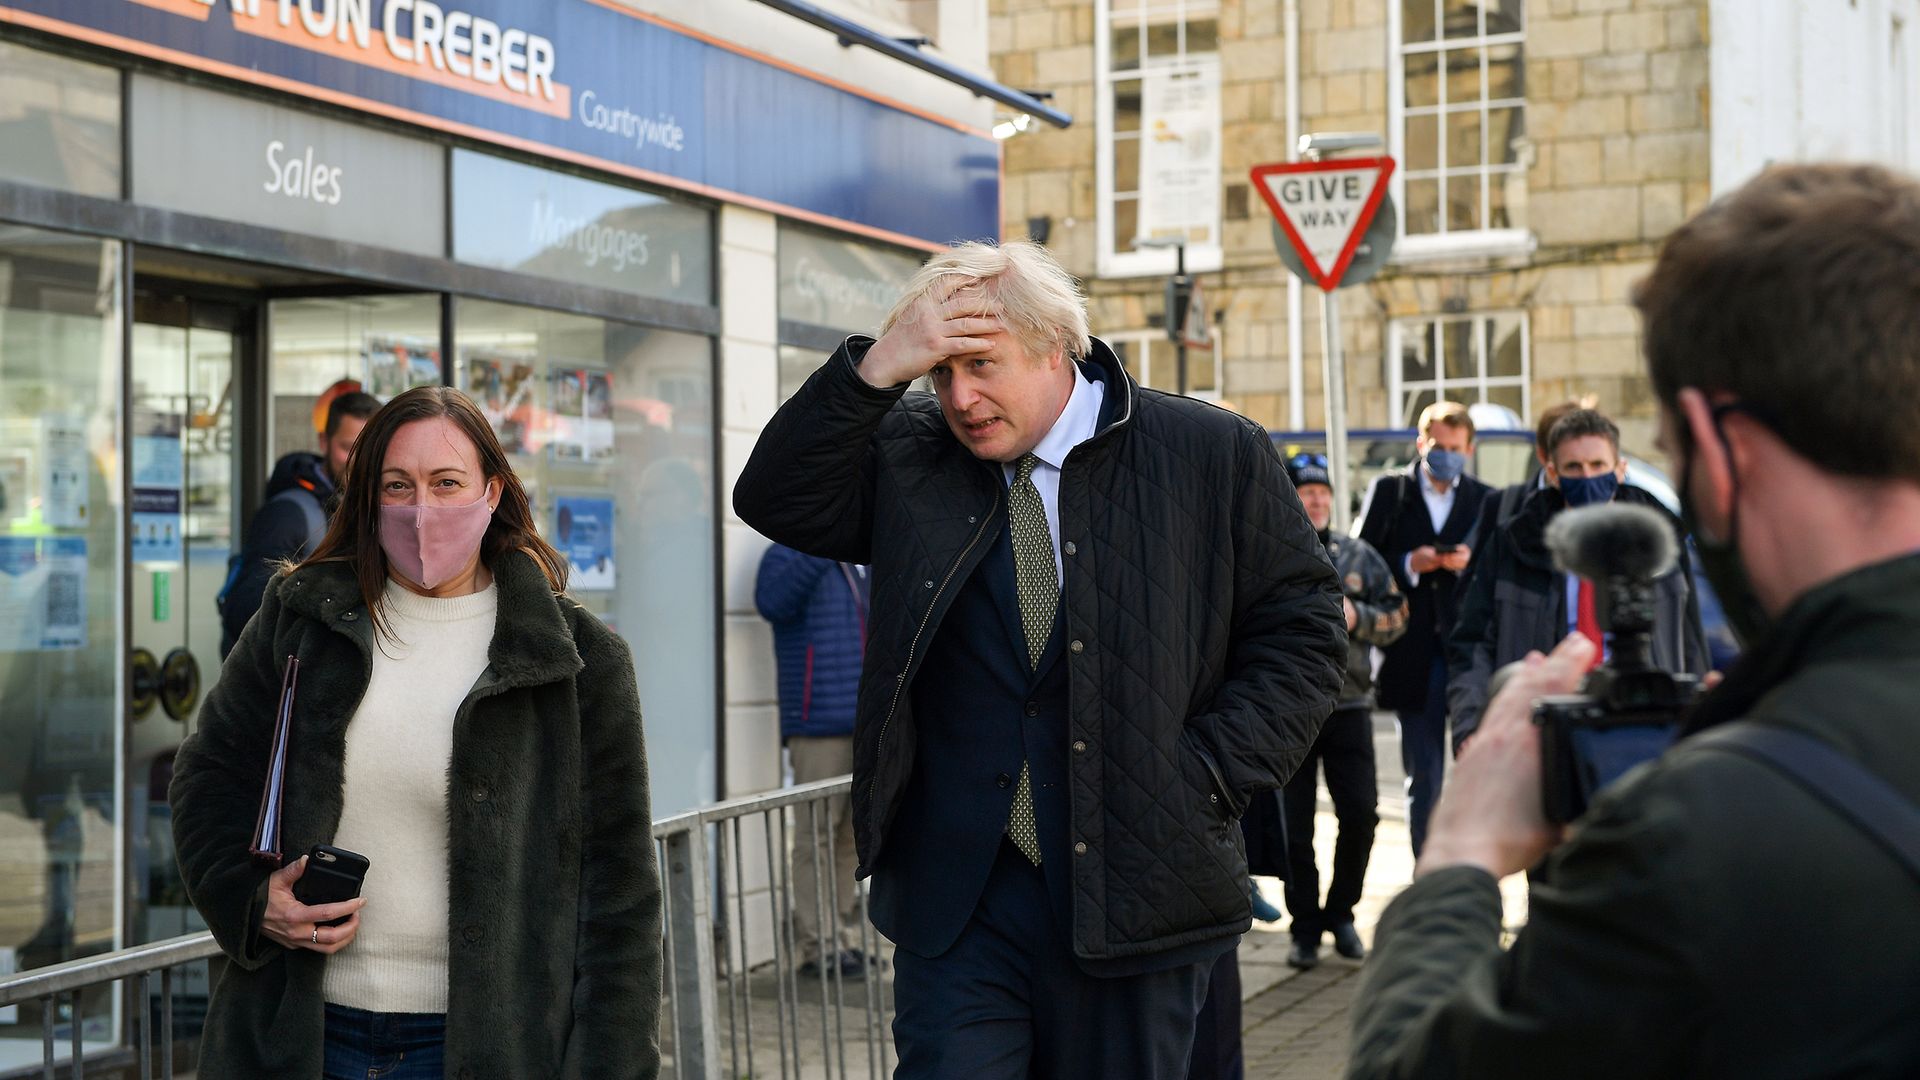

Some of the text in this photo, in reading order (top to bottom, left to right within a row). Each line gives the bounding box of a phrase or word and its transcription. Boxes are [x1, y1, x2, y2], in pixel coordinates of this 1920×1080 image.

[383, 0, 556, 101] CREBER
[579, 89, 684, 151] Countrywide
[264, 140, 343, 205] Sales
[1281, 176, 1361, 203] GIVE
[529, 199, 649, 273] Mortgages
[1299, 209, 1350, 228] WAY
